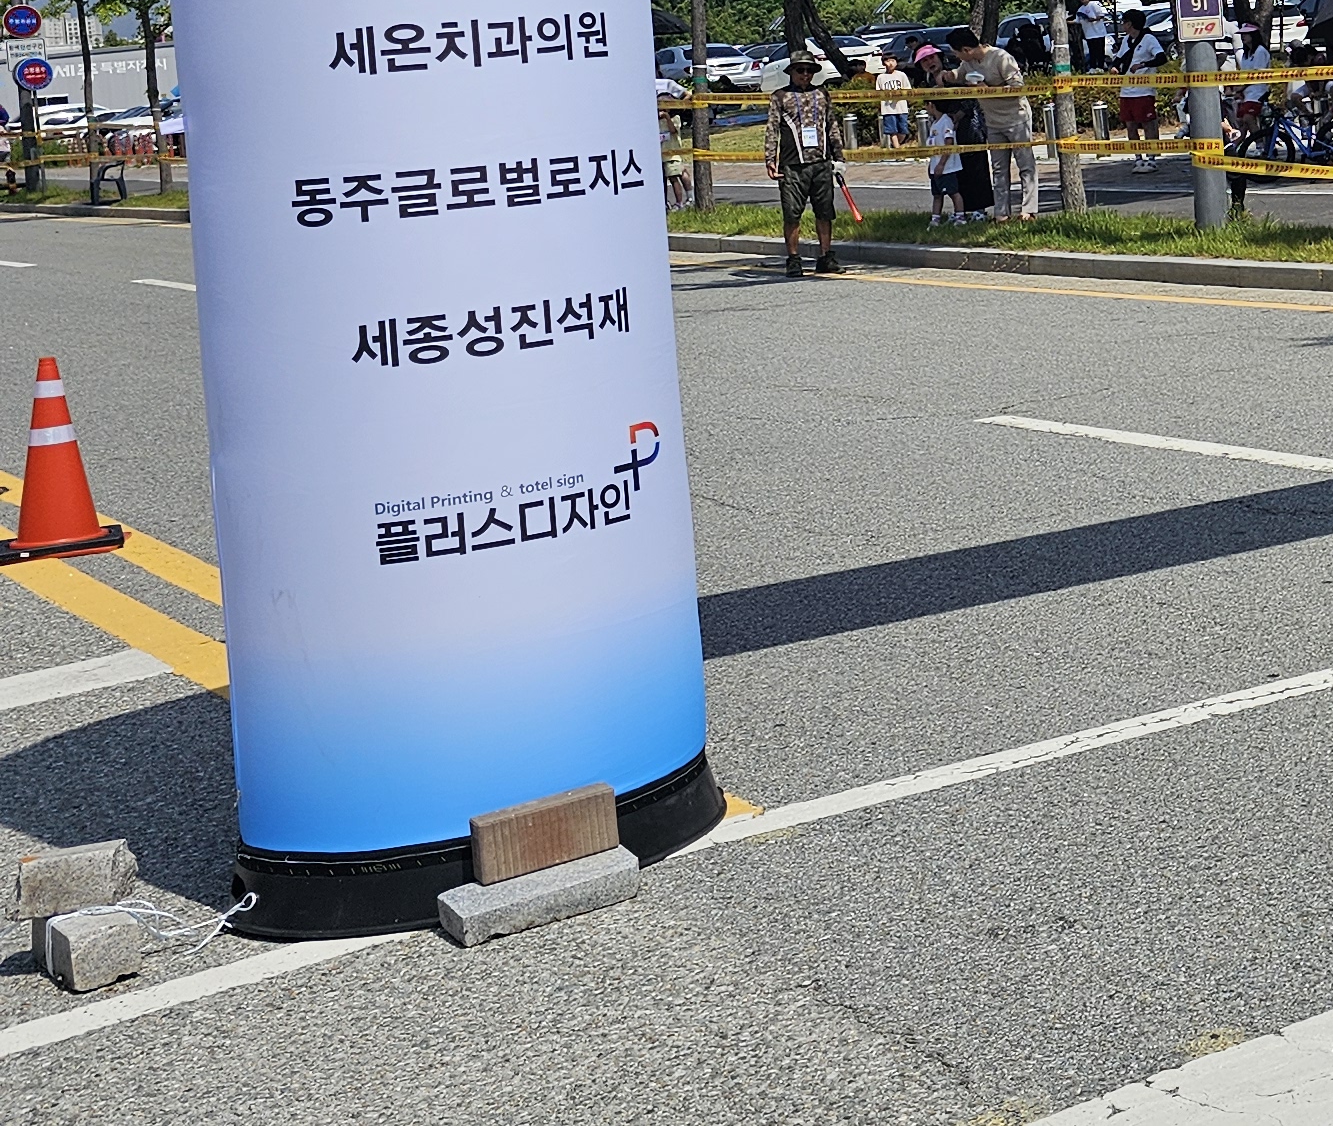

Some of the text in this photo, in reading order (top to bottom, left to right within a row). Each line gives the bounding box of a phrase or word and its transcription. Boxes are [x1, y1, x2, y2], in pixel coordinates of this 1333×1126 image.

[329, 11, 610, 76] 세온치과의원
[290, 148, 645, 228] 동주글로벌로지스
[351, 286, 631, 368] 세종성진석재
[373, 471, 585, 516] Digital Printing & totel sign
[375, 478, 632, 566] 플러스디자인
